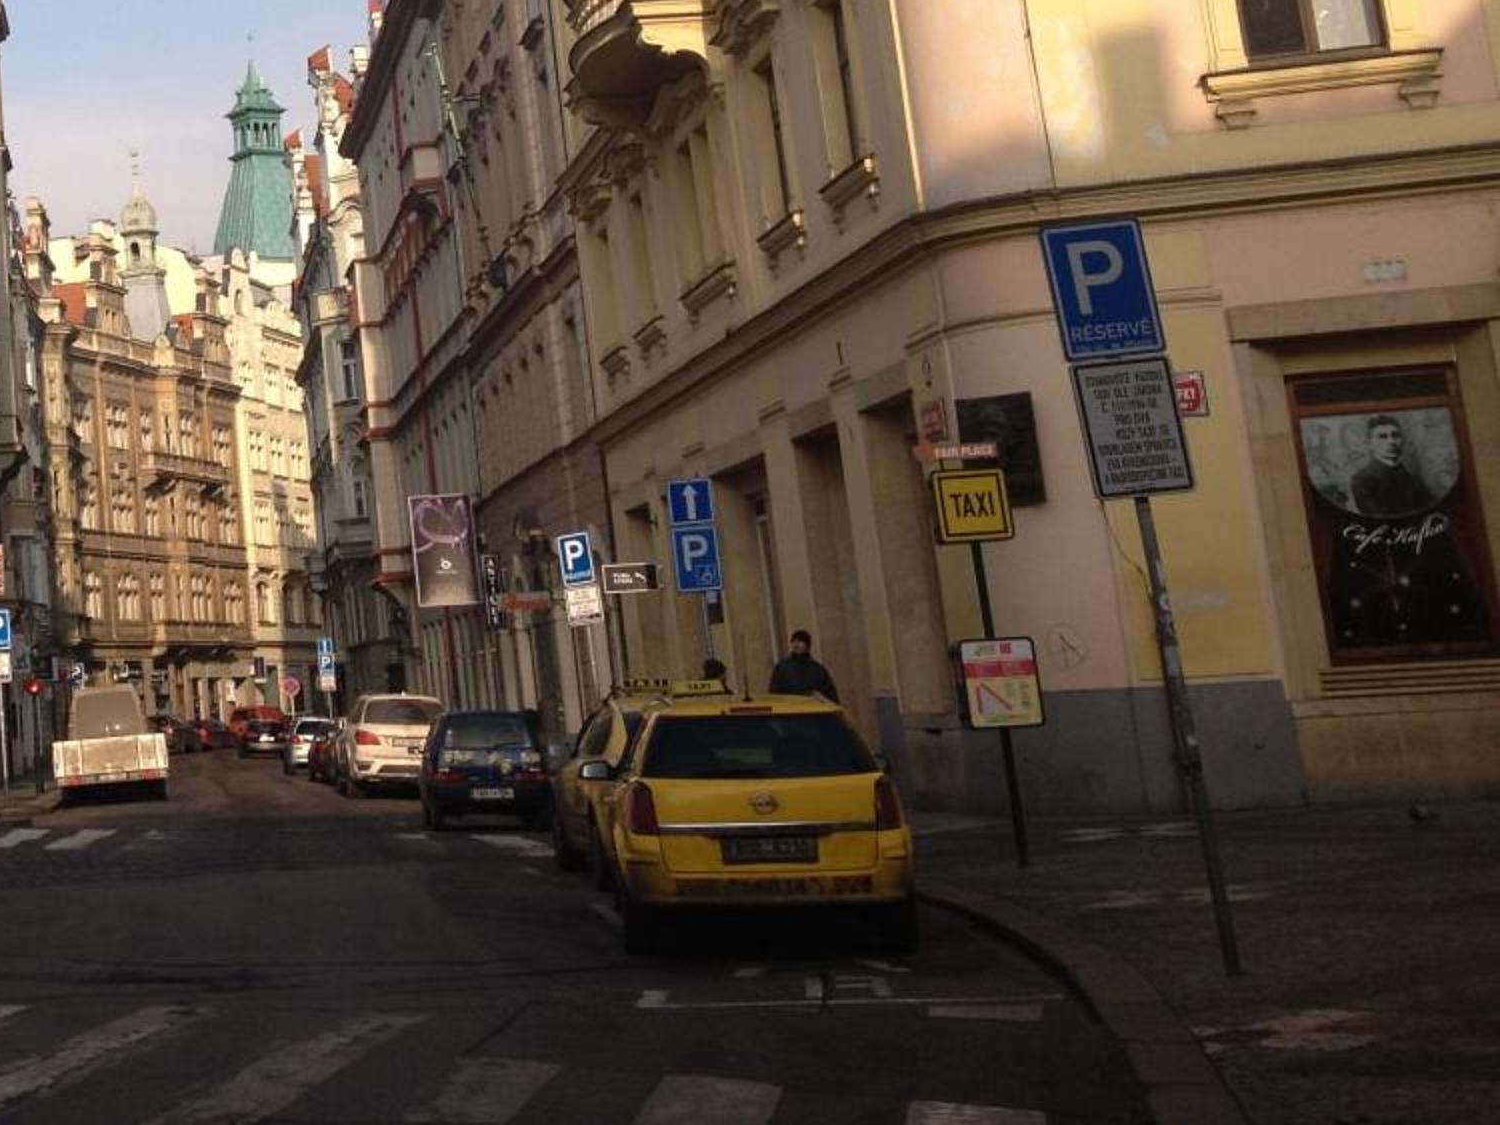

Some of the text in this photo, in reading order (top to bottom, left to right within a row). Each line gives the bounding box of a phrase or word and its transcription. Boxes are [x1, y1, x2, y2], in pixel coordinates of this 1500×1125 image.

[1066, 240, 1124, 316] P
[949, 491, 996, 518] TAXI
[564, 540, 585, 571] P
[682, 535, 708, 572] P
